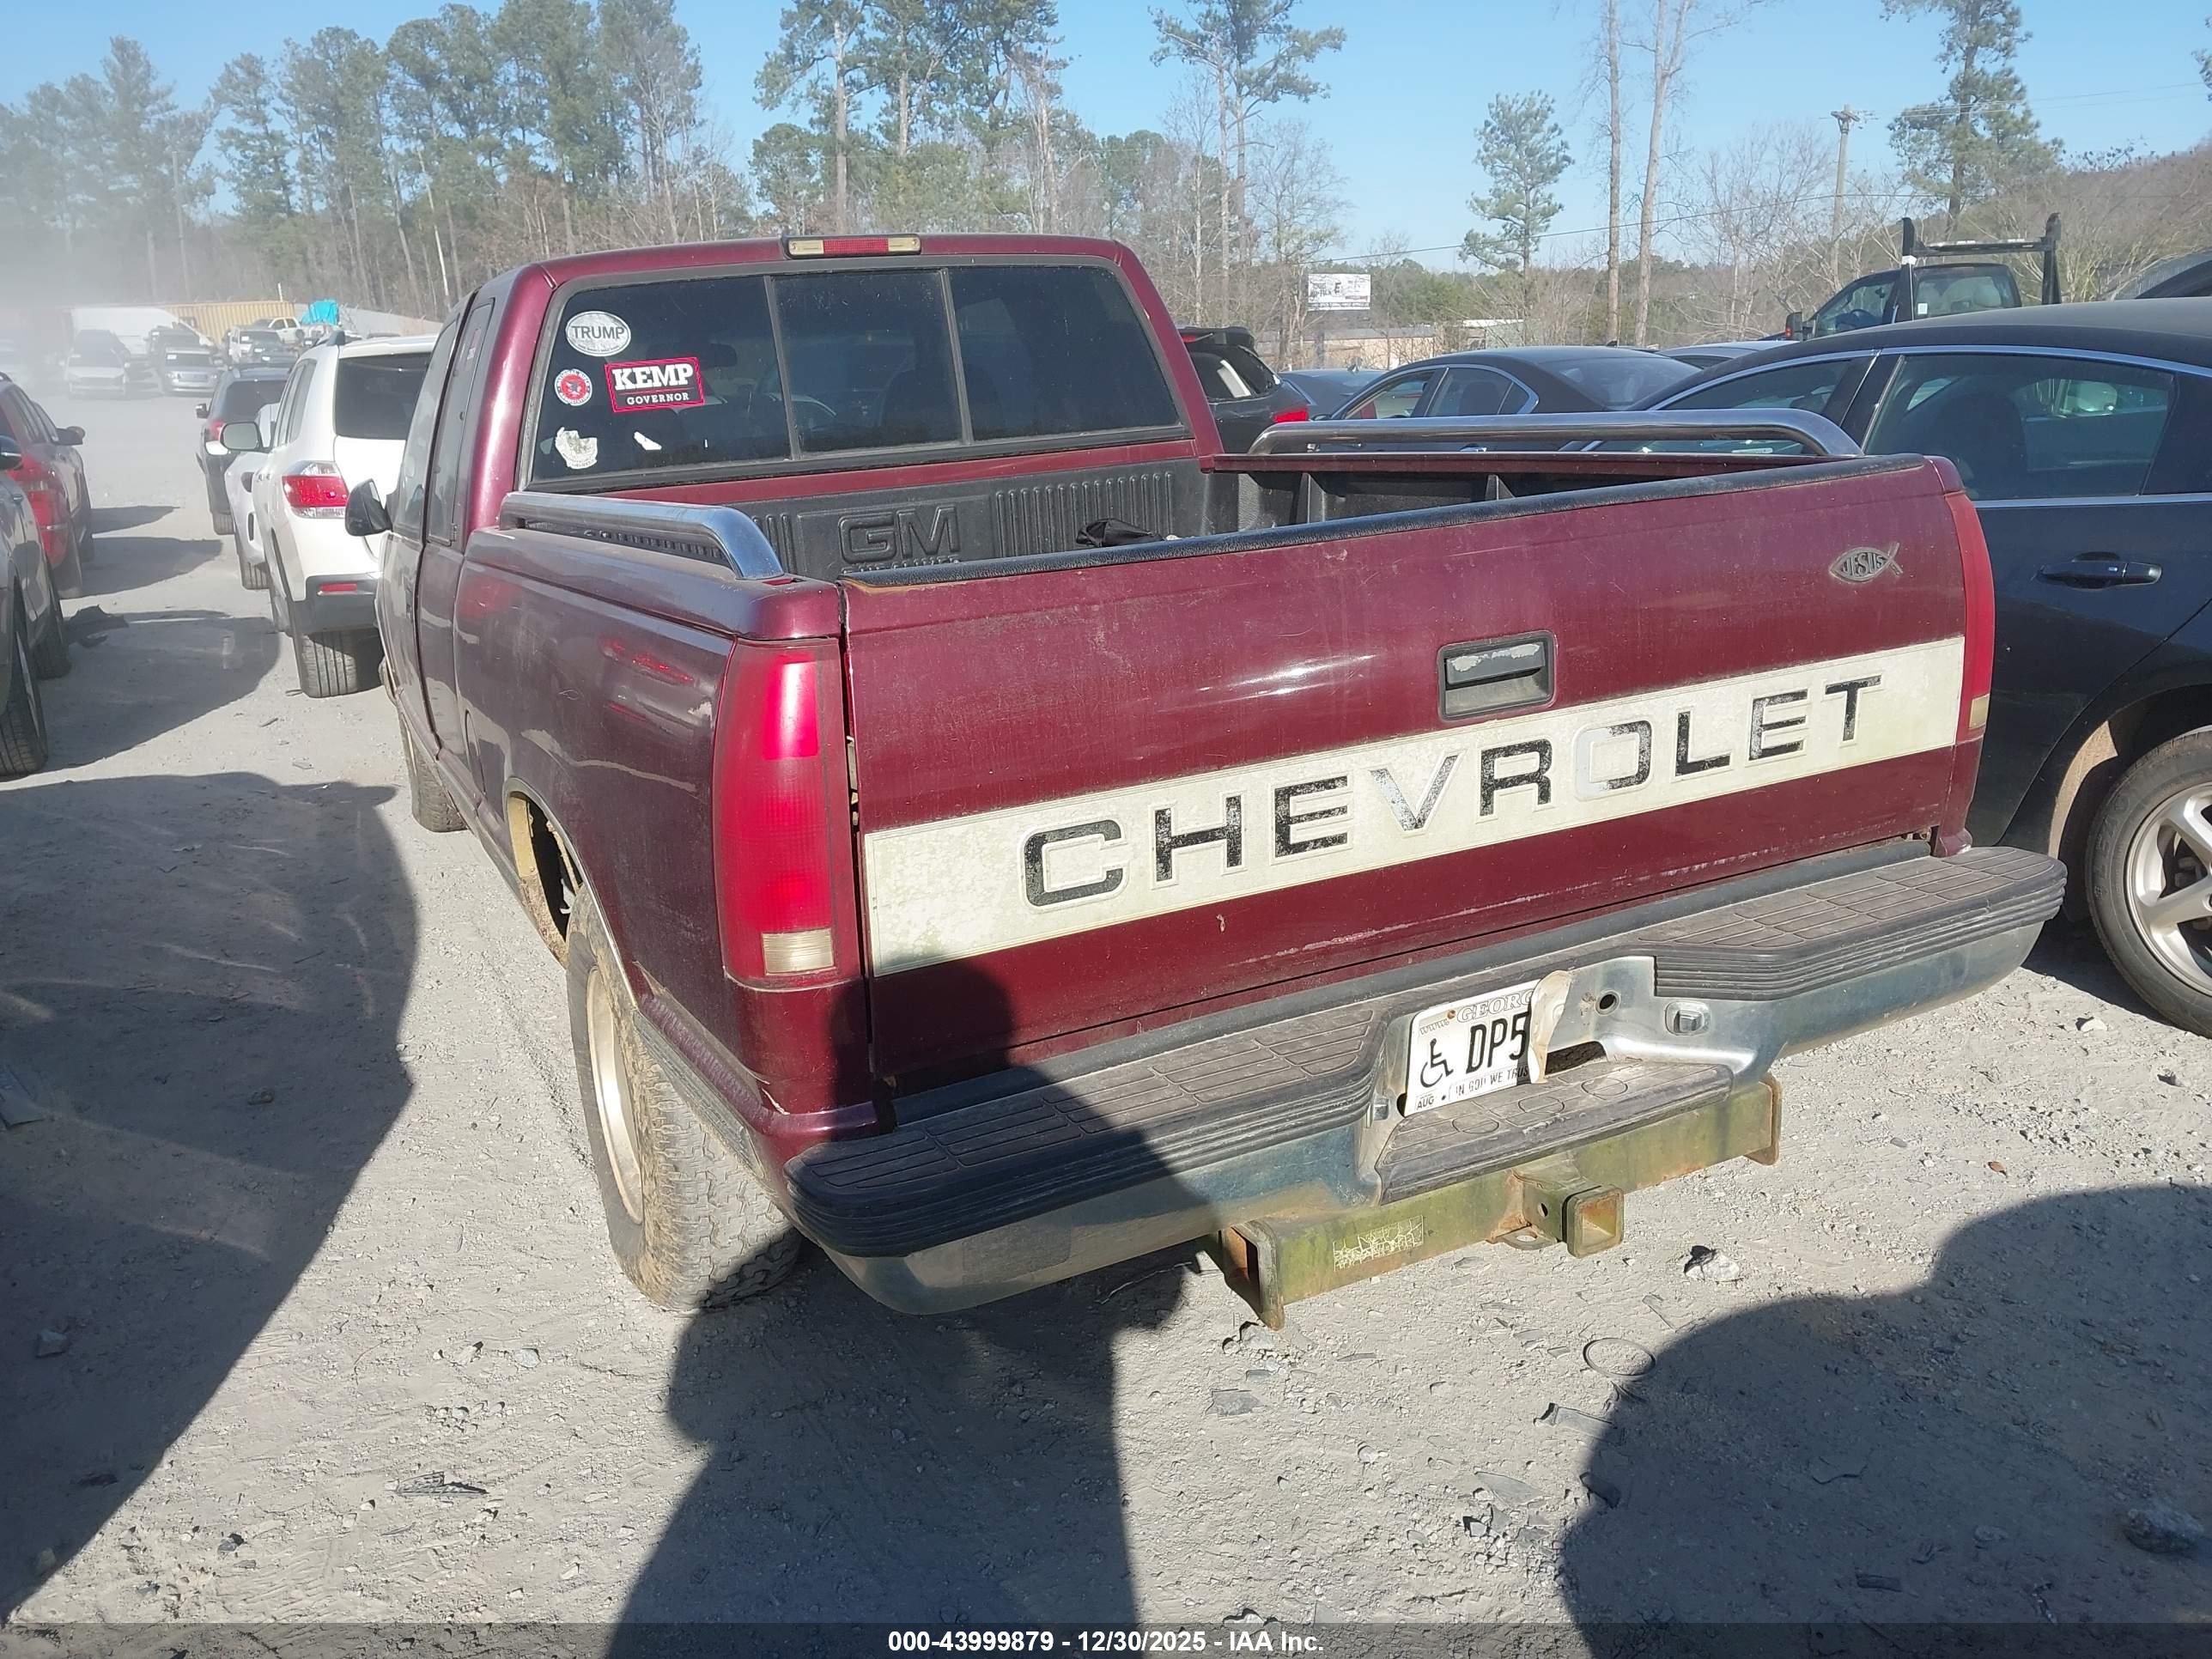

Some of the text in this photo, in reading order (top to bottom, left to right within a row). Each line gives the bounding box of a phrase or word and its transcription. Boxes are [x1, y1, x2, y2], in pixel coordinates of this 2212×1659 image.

[571, 325, 625, 340] TRUMP
[611, 362, 694, 391] KEMP
[626, 392, 690, 405] GOVERNOR
[837, 505, 962, 565] GM
[1841, 552, 1887, 577] JESUS
[1019, 673, 1884, 910] CHEVROLET
[1456, 988, 1533, 1023] GEORG
[1490, 1070, 1504, 1085] WE
[1507, 1066, 1529, 1082] TRUS
[1416, 1095, 1435, 1111] AUG
